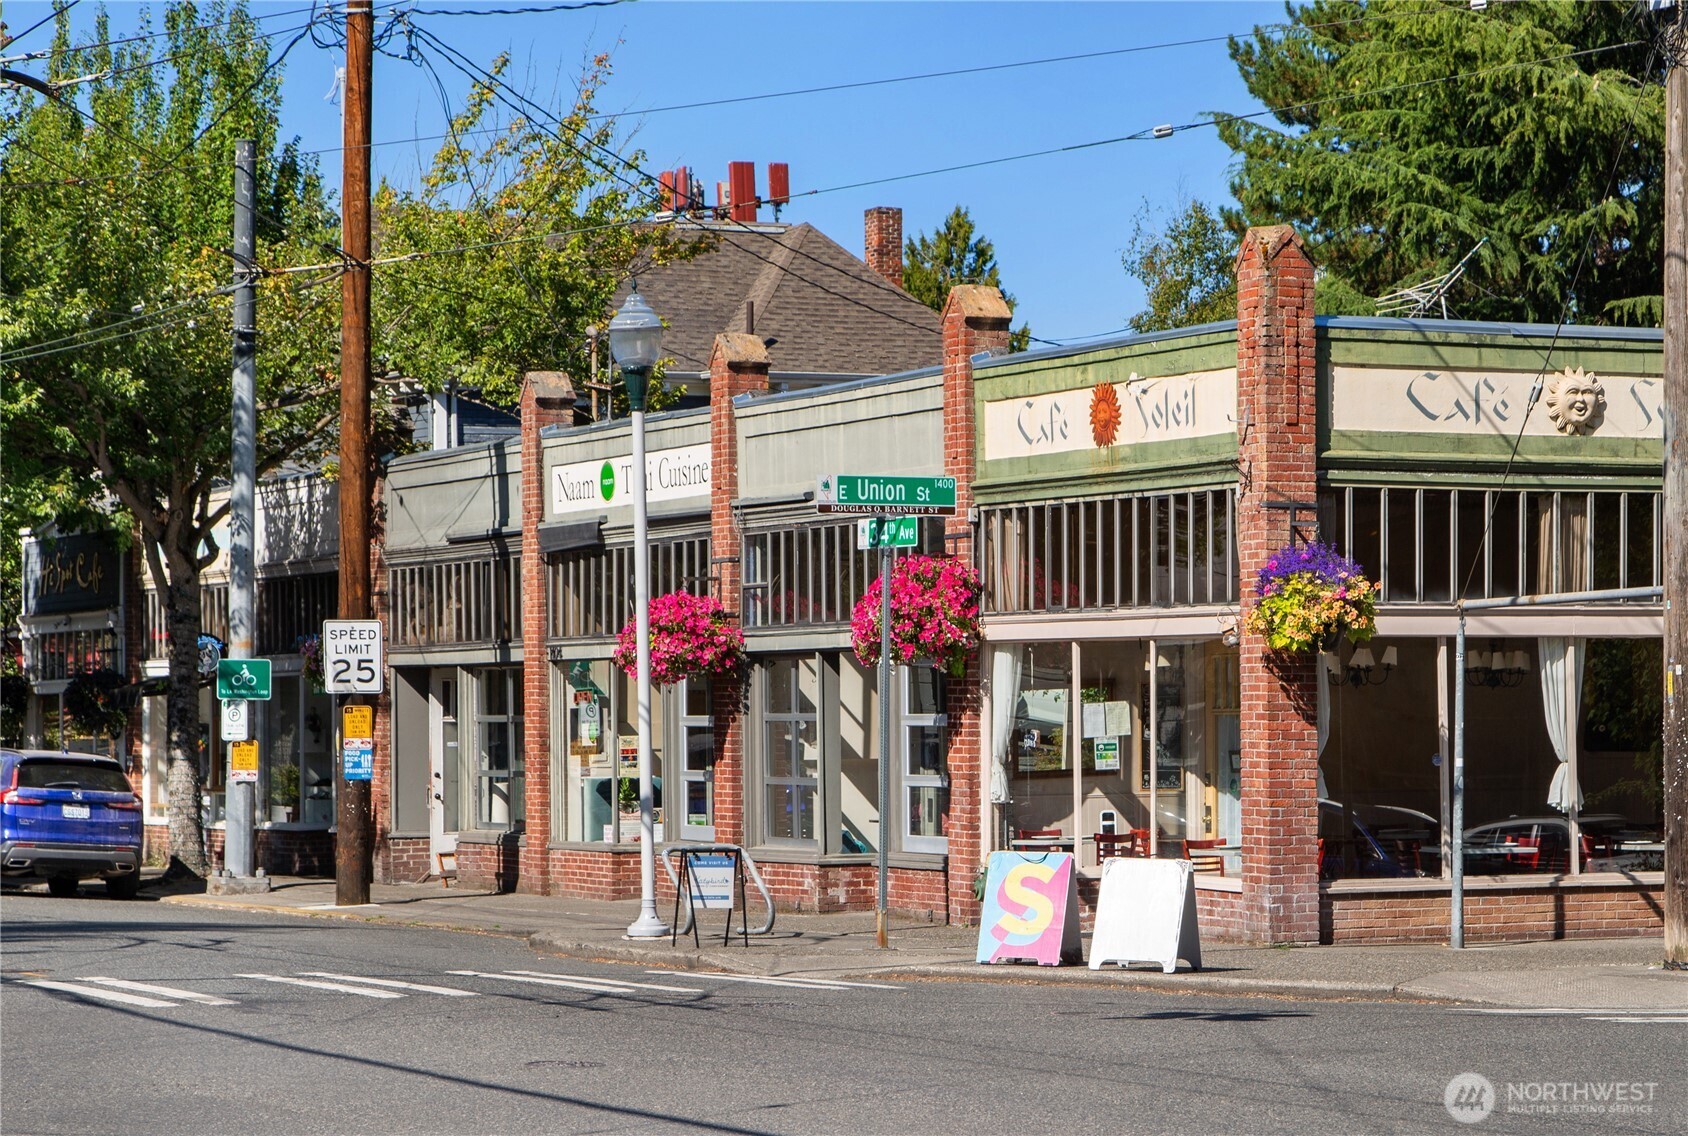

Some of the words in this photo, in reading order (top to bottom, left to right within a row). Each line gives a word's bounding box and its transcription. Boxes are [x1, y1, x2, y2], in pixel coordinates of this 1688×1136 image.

[1406, 371, 1510, 425] Café
[1017, 400, 1068, 445] Café
[1135, 384, 1196, 438] Soleil
[557, 472, 595, 502] Naam
[658, 455, 709, 488] Cuisine
[839, 485, 848, 499] E
[857, 479, 905, 500] Union
[916, 487, 930, 501] St
[934, 479, 954, 489] 1400
[831, 505, 872, 513] DOUGLAS
[873, 505, 883, 514] Q.
[884, 506, 925, 514] BARNETT
[928, 506, 940, 514] ST
[869, 522, 896, 544] 34th
[899, 525, 914, 540] Ave
[39, 554, 54, 597] Hi
[54, 552, 74, 594] Spot
[330, 629, 377, 640] SPEED
[335, 644, 371, 654] LIMIT
[332, 658, 375, 683] 25
